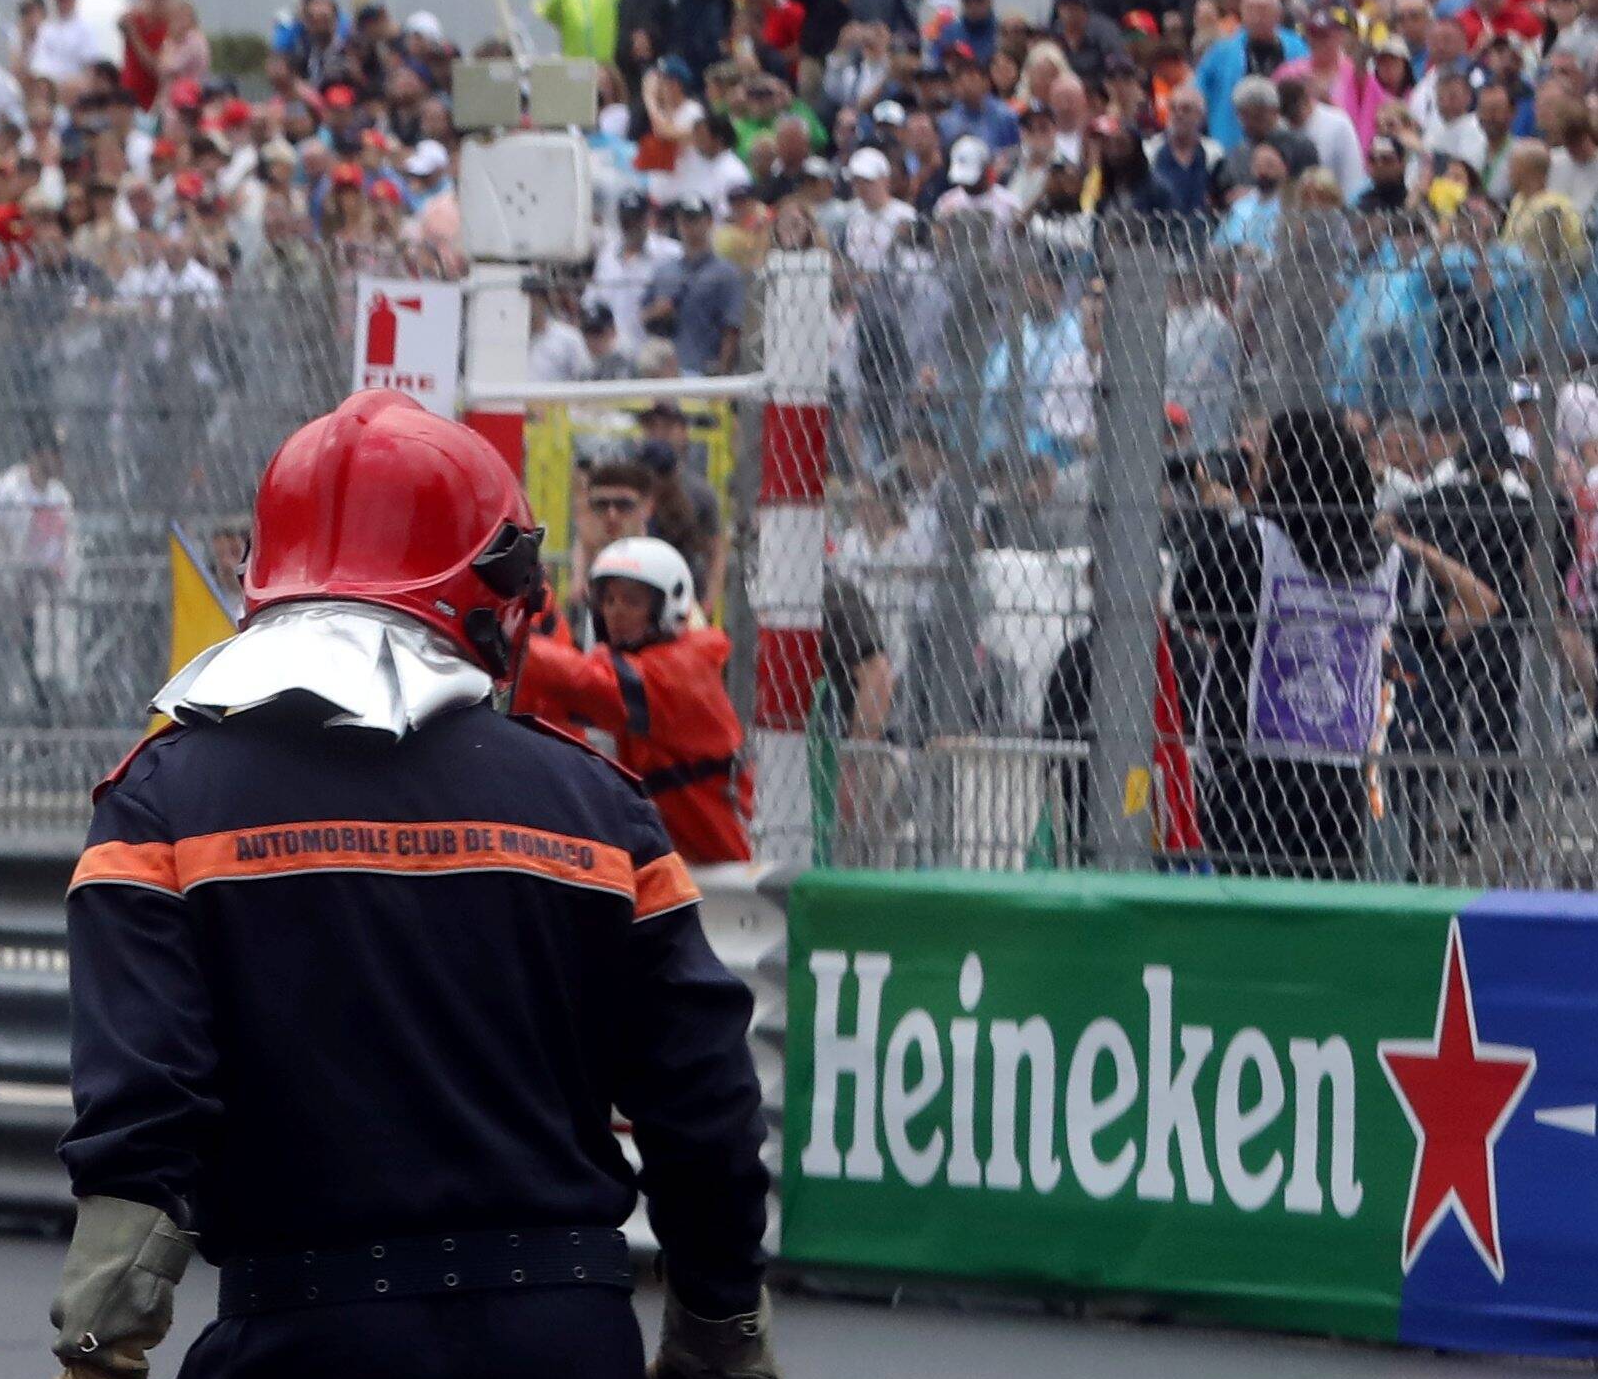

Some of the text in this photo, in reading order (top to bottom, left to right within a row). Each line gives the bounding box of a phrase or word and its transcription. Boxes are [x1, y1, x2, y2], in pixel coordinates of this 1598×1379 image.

[236, 827, 595, 871] AUTOMOBILE CLUB DE MONACO
[801, 949, 1363, 1219] Heineken
